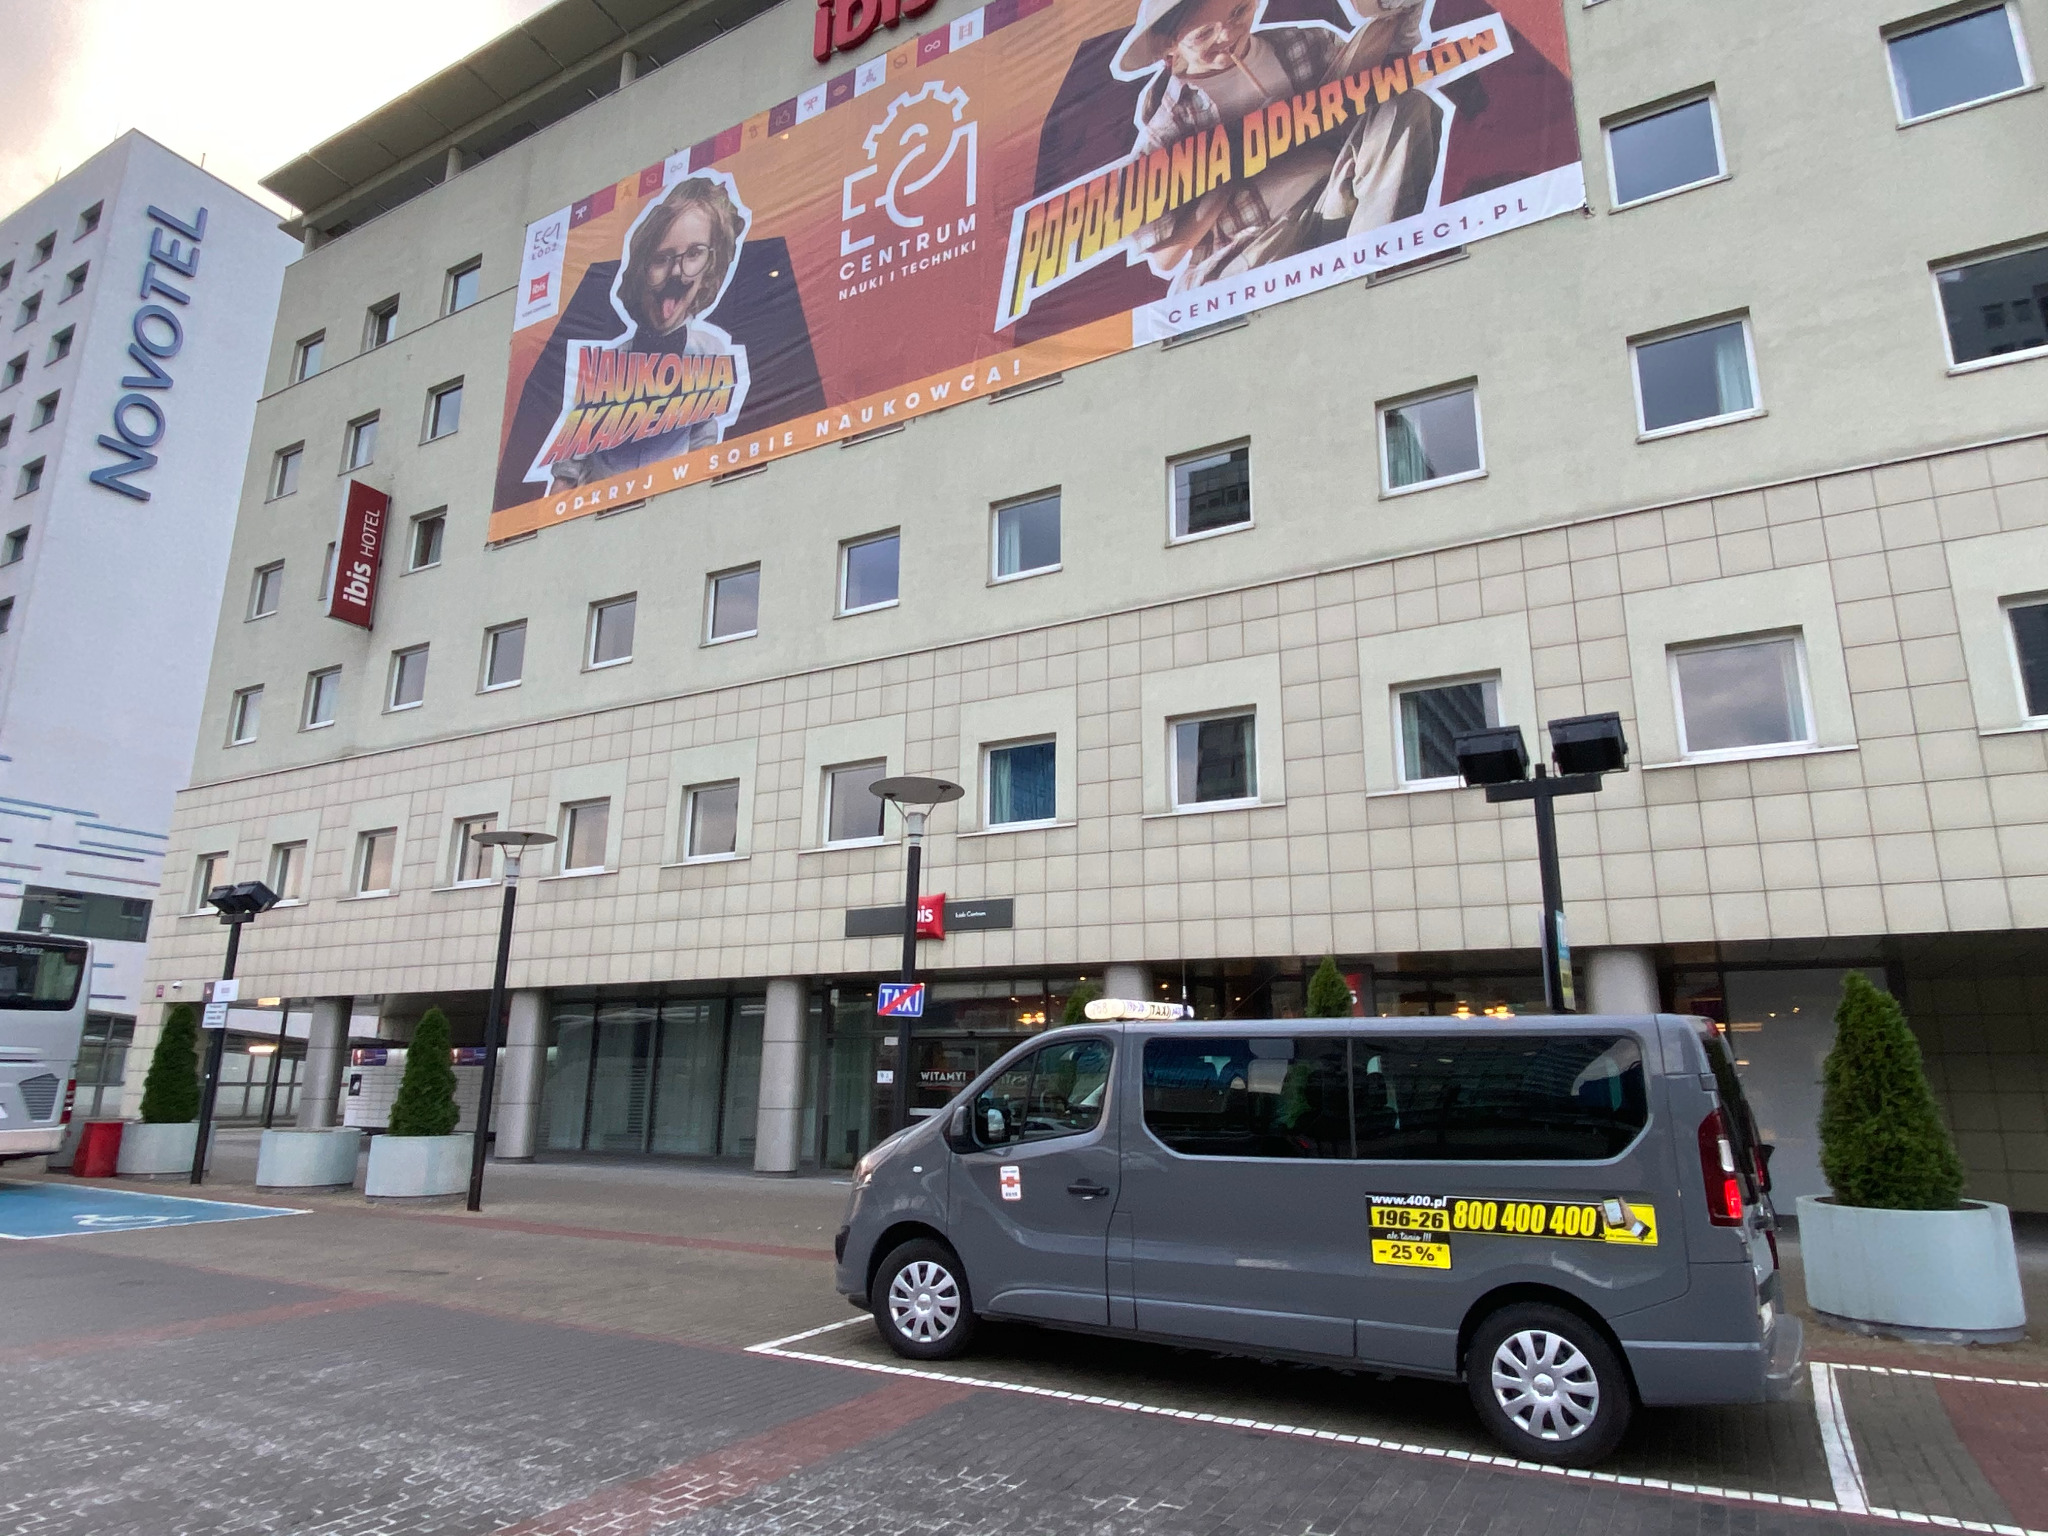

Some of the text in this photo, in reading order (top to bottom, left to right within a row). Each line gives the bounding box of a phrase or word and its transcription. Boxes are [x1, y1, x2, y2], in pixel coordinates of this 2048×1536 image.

[1011, 28, 1498, 316] POPOŁUDNIA ODKRYWCÓW
[838, 239, 976, 301] NAUKI I TECHNIKI
[839, 213, 976, 281] CENTRUM
[1168, 198, 1530, 324] CENTRUMNAUKIEC1.PL
[532, 282, 546, 295] ibis
[89, 204, 209, 501] NOVOTEL
[574, 346, 736, 405] NAUKOWA
[539, 388, 732, 467] AKADEMIA
[555, 358, 1021, 516] ODKRYJ W SOBIE NAUKOWCA!
[343, 509, 380, 607] ibis HOTEL
[881, 988, 920, 1013] TAXI
[920, 1071, 967, 1082] WITAMY!
[1371, 1195, 1447, 1209] www.400.pl
[1376, 1210, 1444, 1229] 196-26
[1453, 1200, 1597, 1237] 800 400 400
[1386, 1231, 1399, 1240] ale
